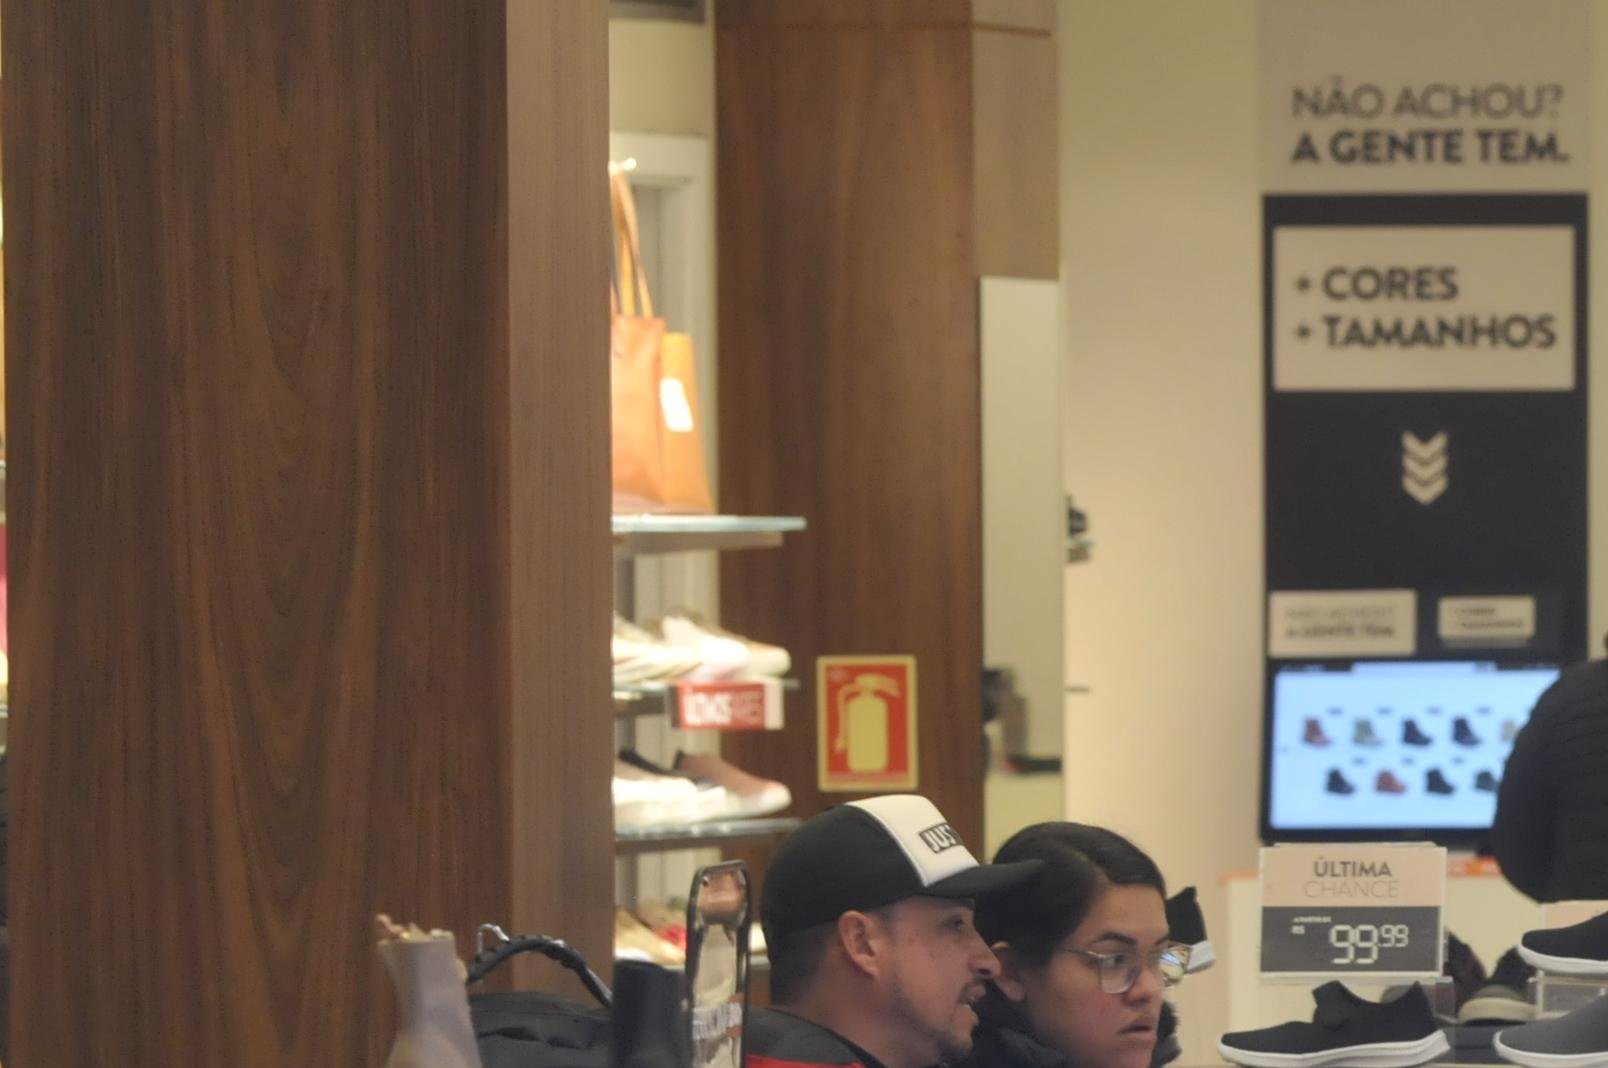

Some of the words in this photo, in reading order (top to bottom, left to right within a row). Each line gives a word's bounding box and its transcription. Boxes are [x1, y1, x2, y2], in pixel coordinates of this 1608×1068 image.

[1393, 83, 1564, 119] ACHOU?
[1293, 131, 1319, 162] A
[1329, 130, 1462, 163] GENTE
[1322, 267, 1458, 300] CORES
[1323, 315, 1557, 348] TAMANHOS
[1313, 856, 1393, 877] ÚLTIMA
[1303, 880, 1400, 898] CHANCE
